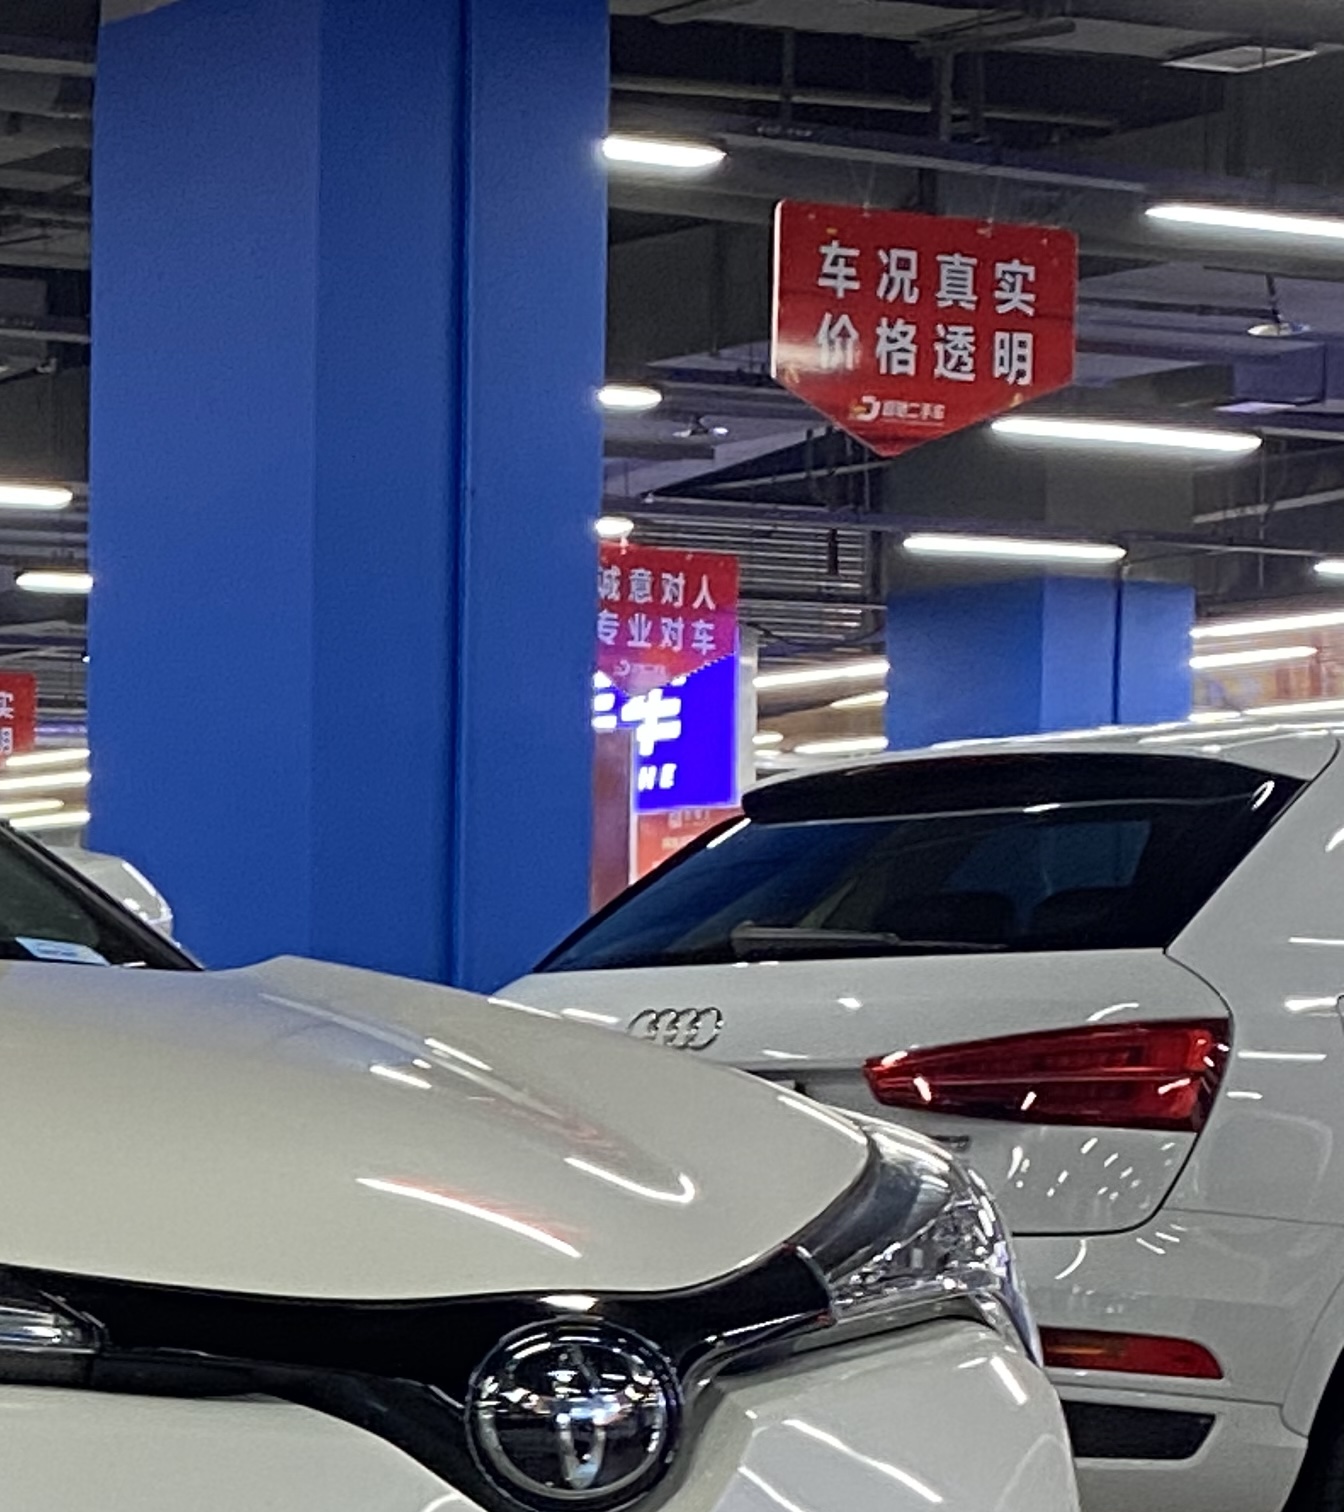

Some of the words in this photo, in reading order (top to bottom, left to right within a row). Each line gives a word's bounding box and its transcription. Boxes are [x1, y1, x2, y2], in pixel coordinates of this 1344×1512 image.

[816, 240, 1037, 317] 车况真实
[815, 312, 1035, 387] 价格透明
[597, 564, 716, 611] 诚意对人
[597, 608, 716, 656] 专业对车
